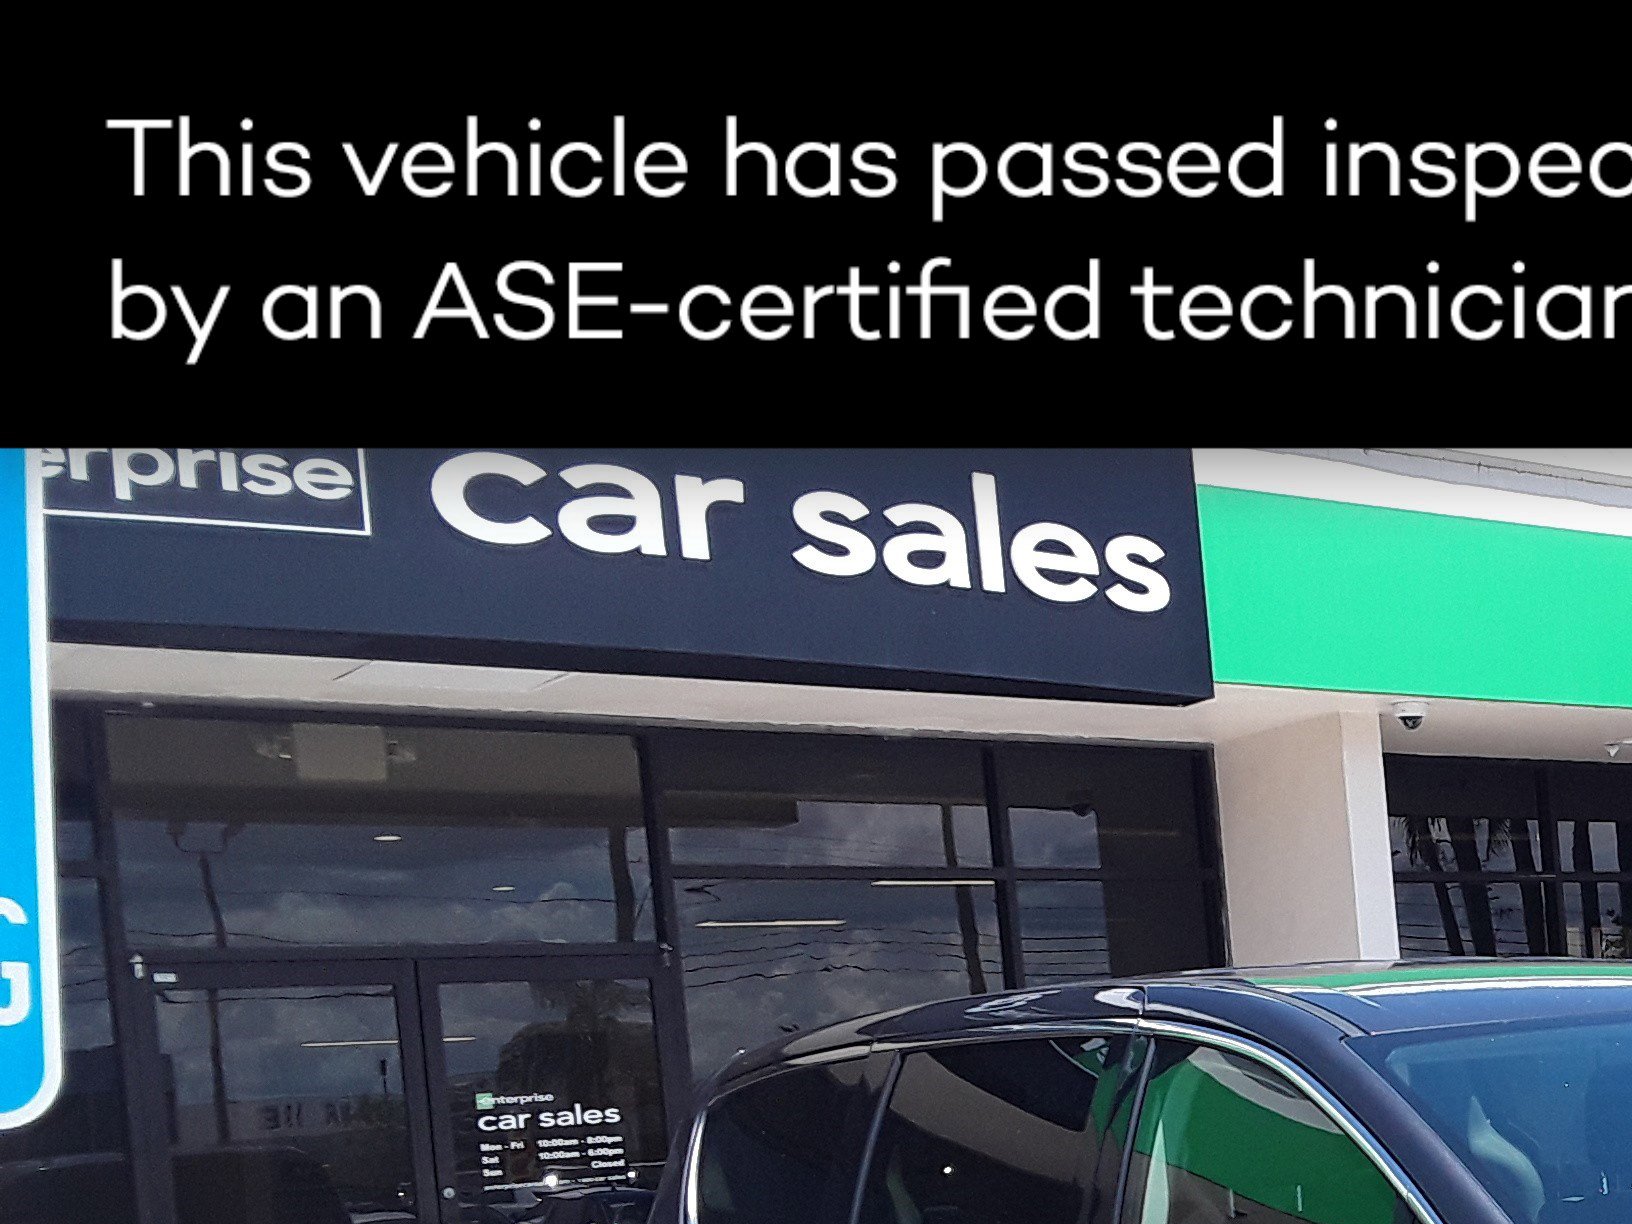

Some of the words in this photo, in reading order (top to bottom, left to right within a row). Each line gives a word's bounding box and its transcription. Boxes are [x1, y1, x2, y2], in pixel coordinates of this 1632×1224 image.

[42, 447, 355, 500] rprise
[431, 452, 744, 559] car
[792, 472, 1170, 612] sales
[478, 1113, 531, 1131] car
[539, 1103, 621, 1127] sales
